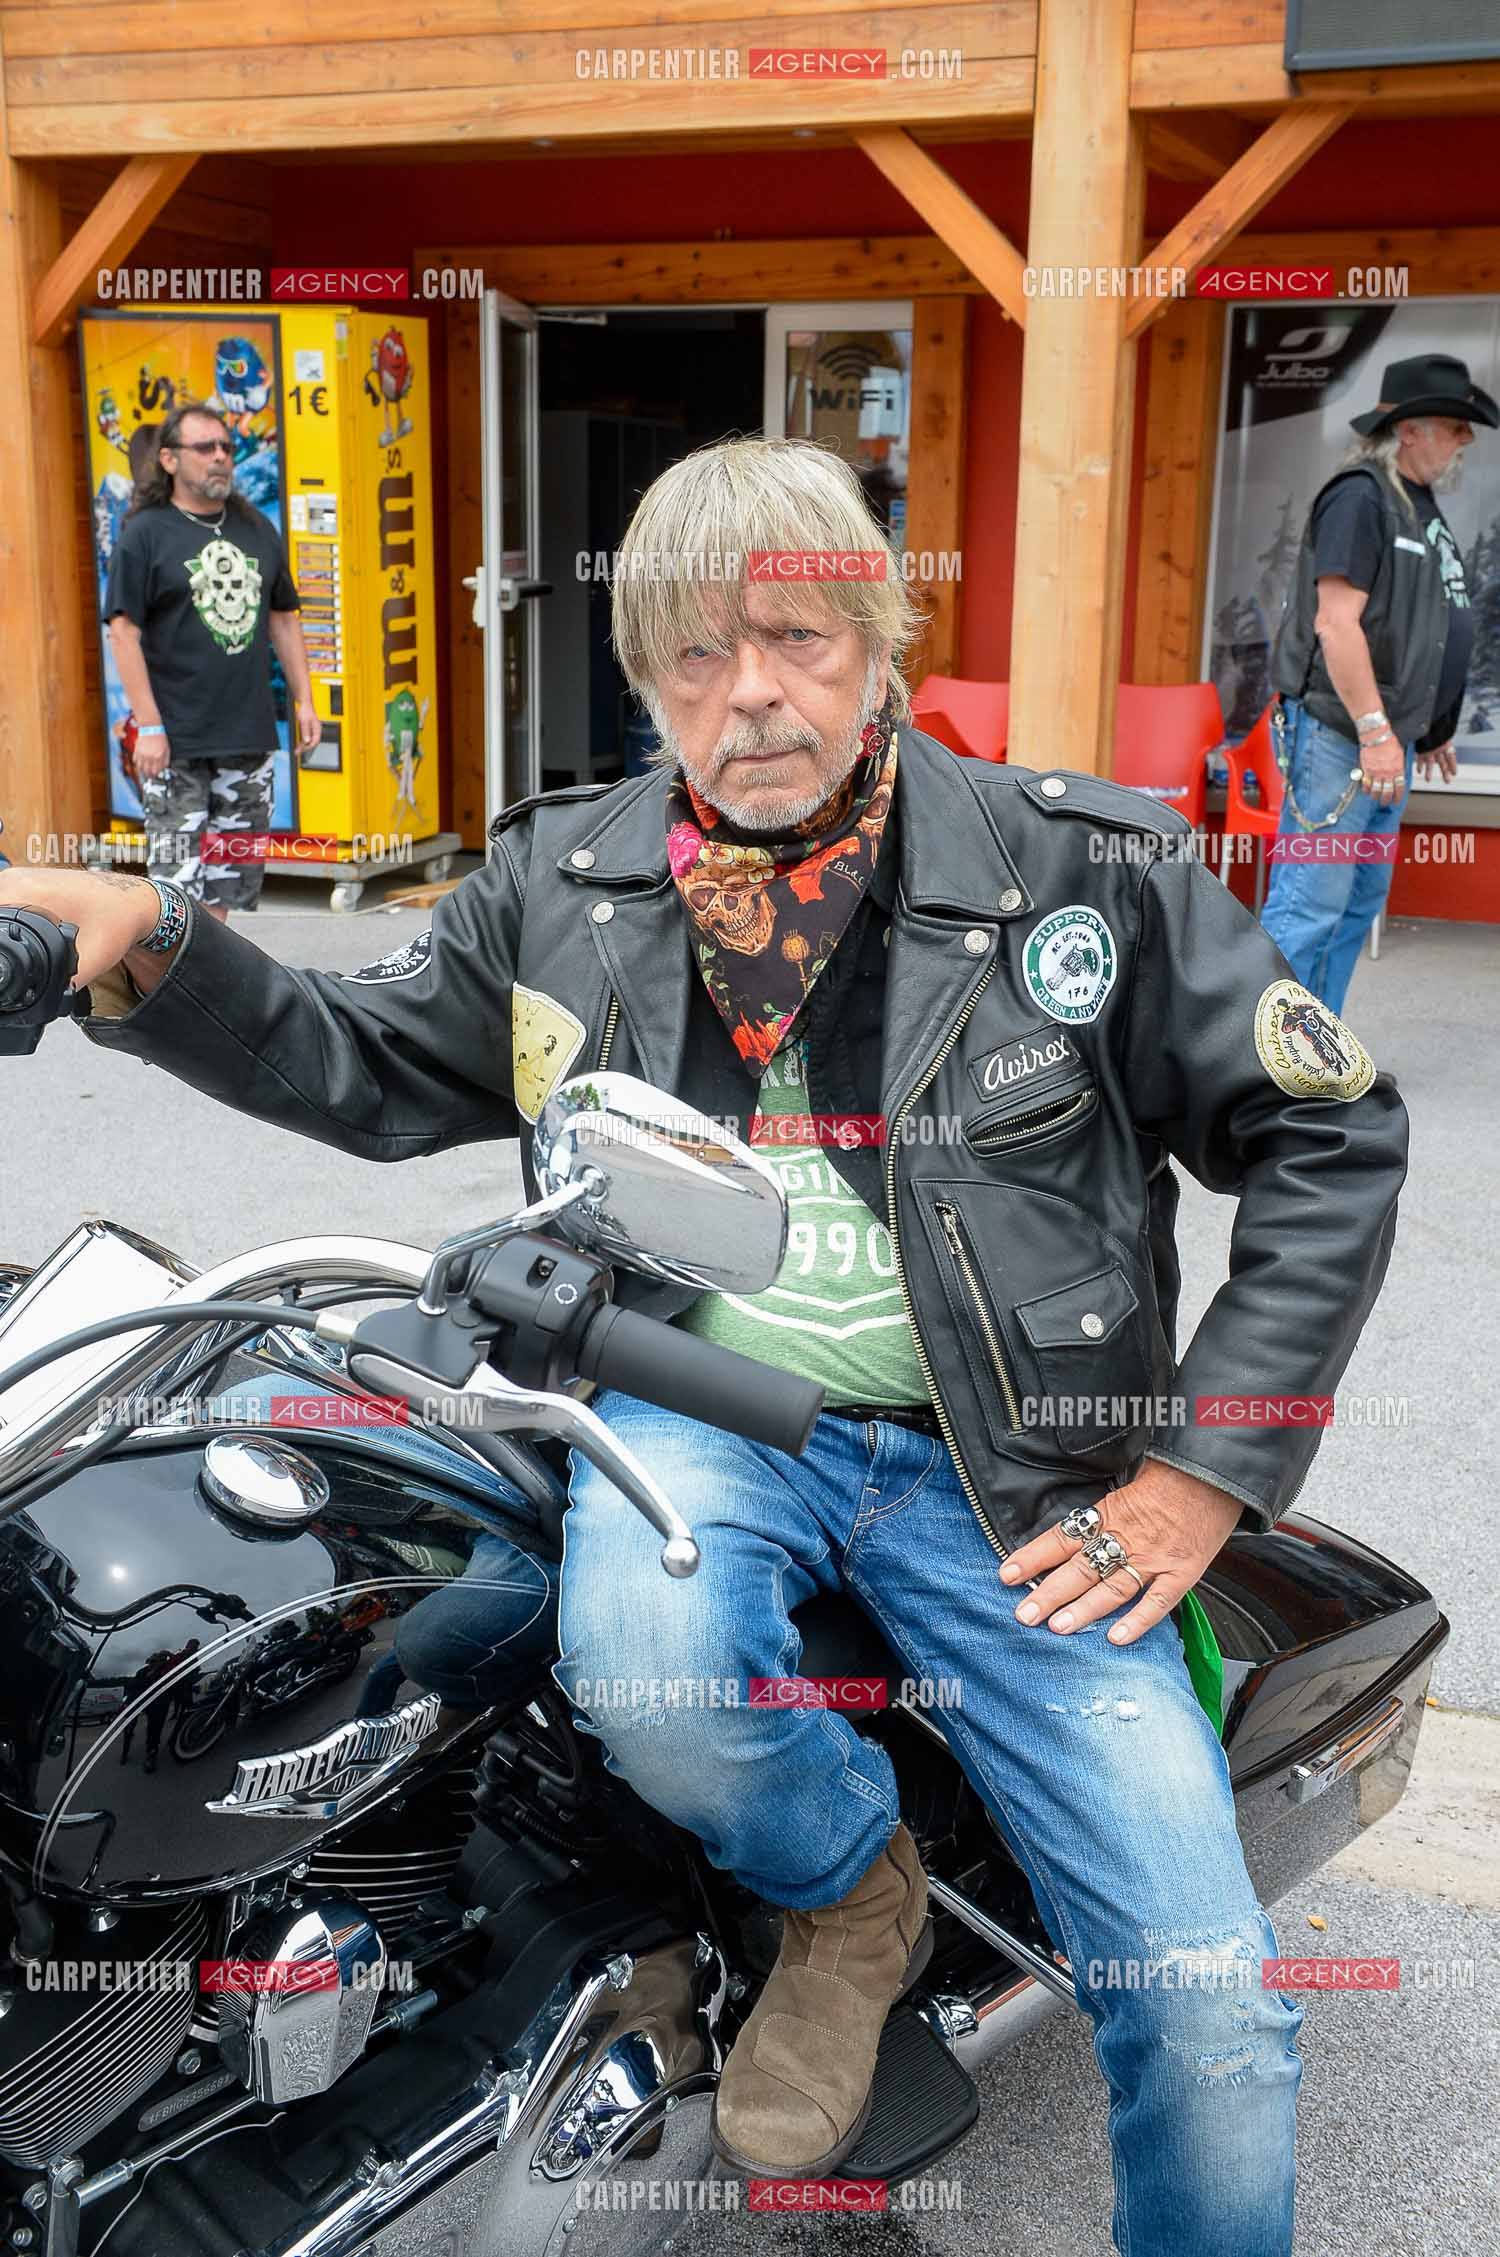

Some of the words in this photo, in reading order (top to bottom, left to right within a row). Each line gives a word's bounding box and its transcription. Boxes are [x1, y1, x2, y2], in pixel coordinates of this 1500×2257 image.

[810, 388, 895, 411] WiFi
[1033, 911, 1105, 948] SUPPORT
[1036, 987, 1067, 1017] GREEN
[1069, 1006, 1094, 1018] AND
[1068, 986, 1089, 1000] 176
